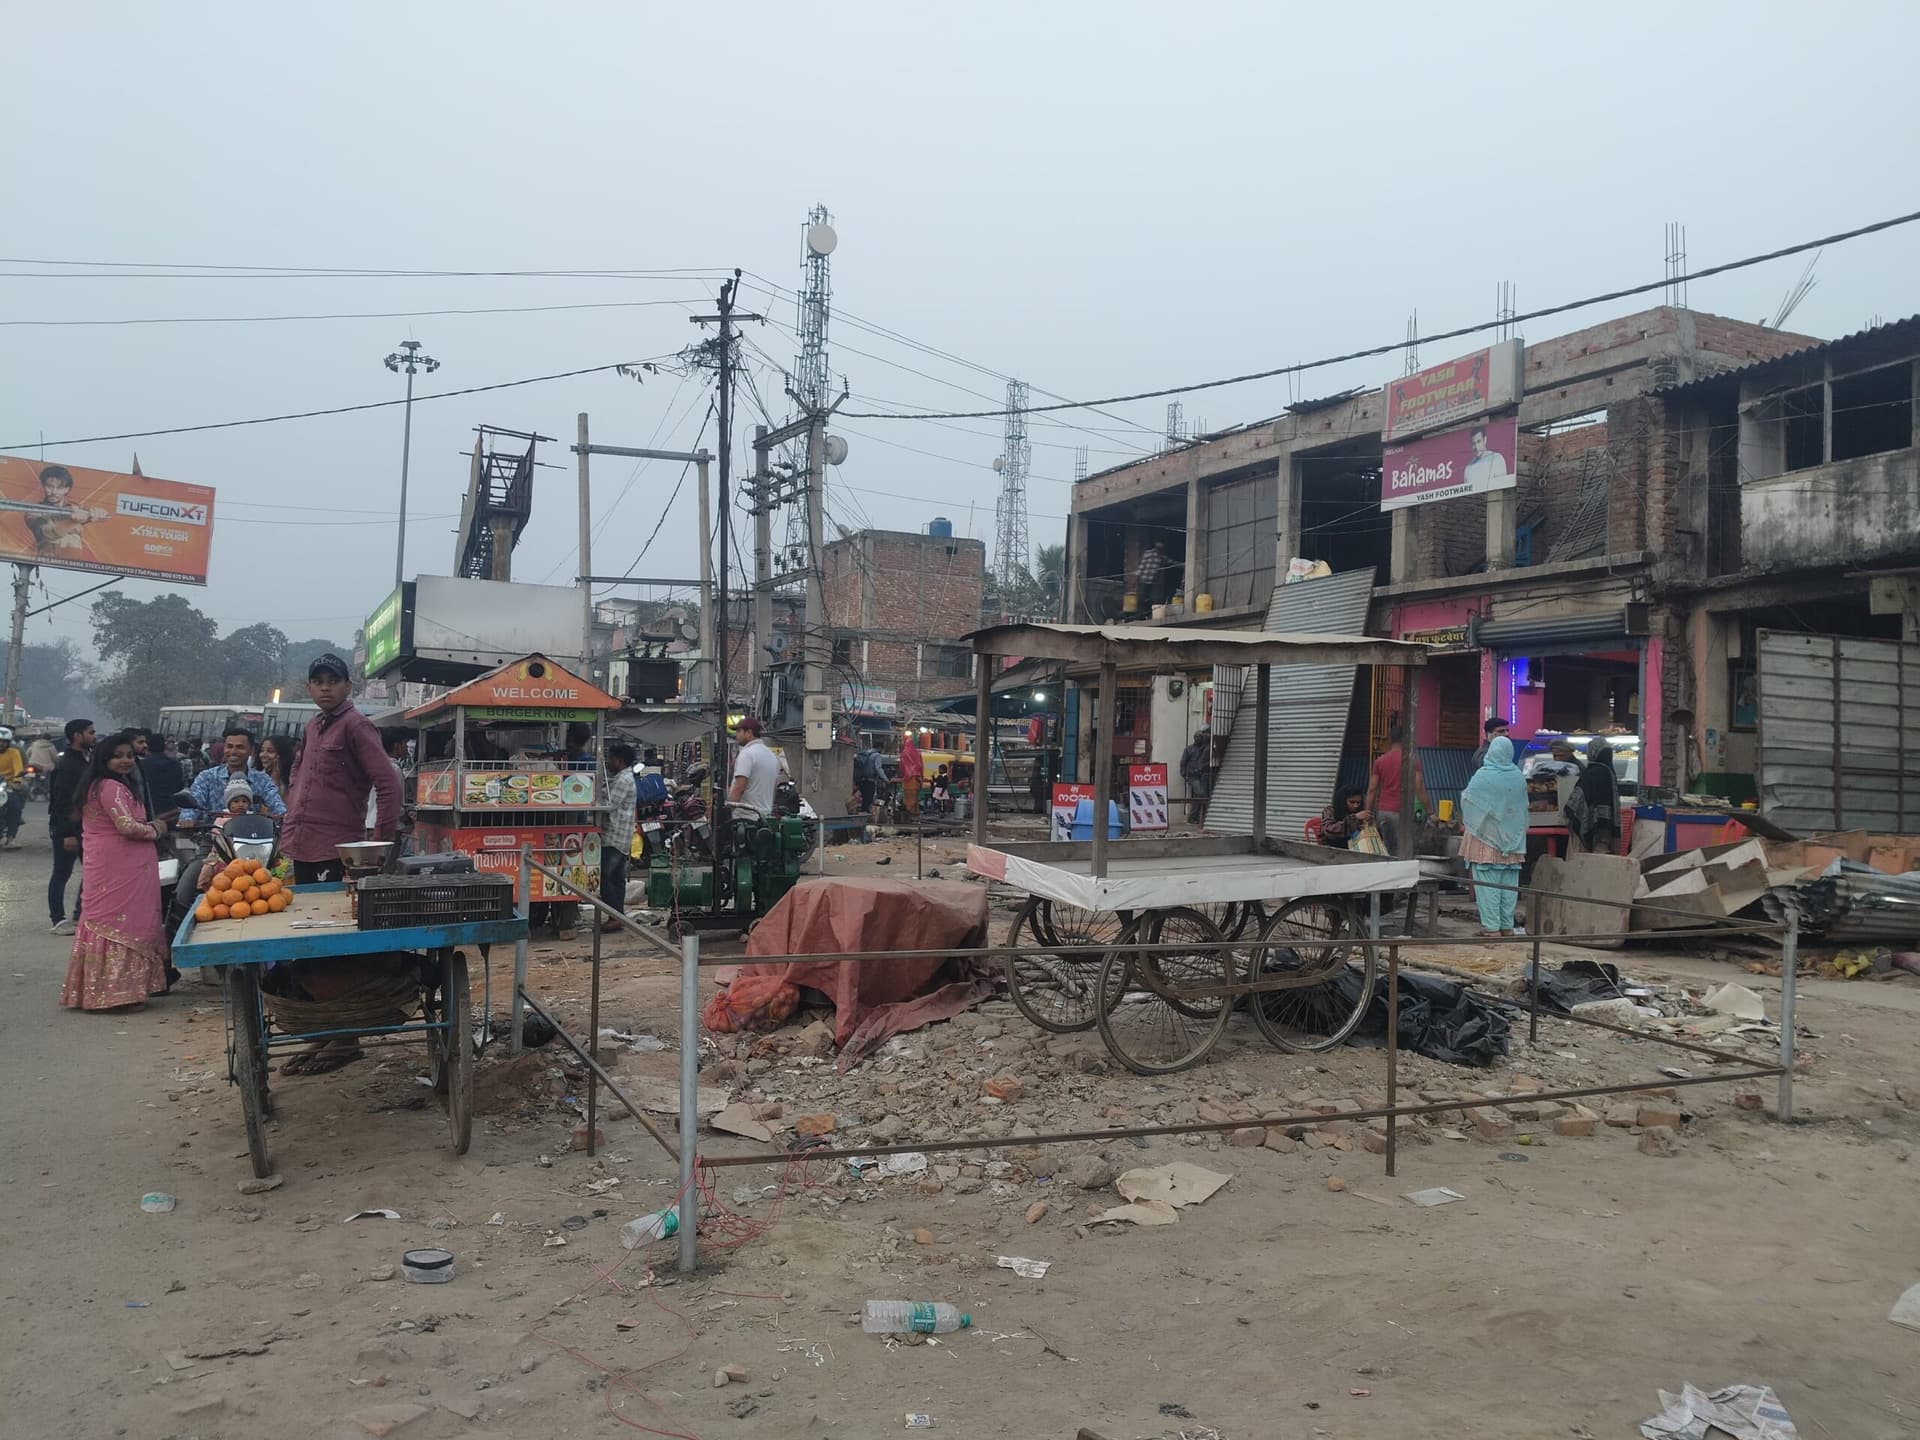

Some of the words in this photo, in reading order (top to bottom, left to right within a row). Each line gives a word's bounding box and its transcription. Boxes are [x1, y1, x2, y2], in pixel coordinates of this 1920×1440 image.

[1421, 366, 1456, 388] YASH
[1400, 376, 1475, 411] FOOTWEAR
[1392, 460, 1453, 490] Bahamas
[1416, 492, 1435, 502] YASH
[1435, 484, 1473, 499] FOOTWARE
[492, 687, 578, 700] WELCOME
[486, 707, 541, 719] BURGER
[545, 708, 576, 720] KING
